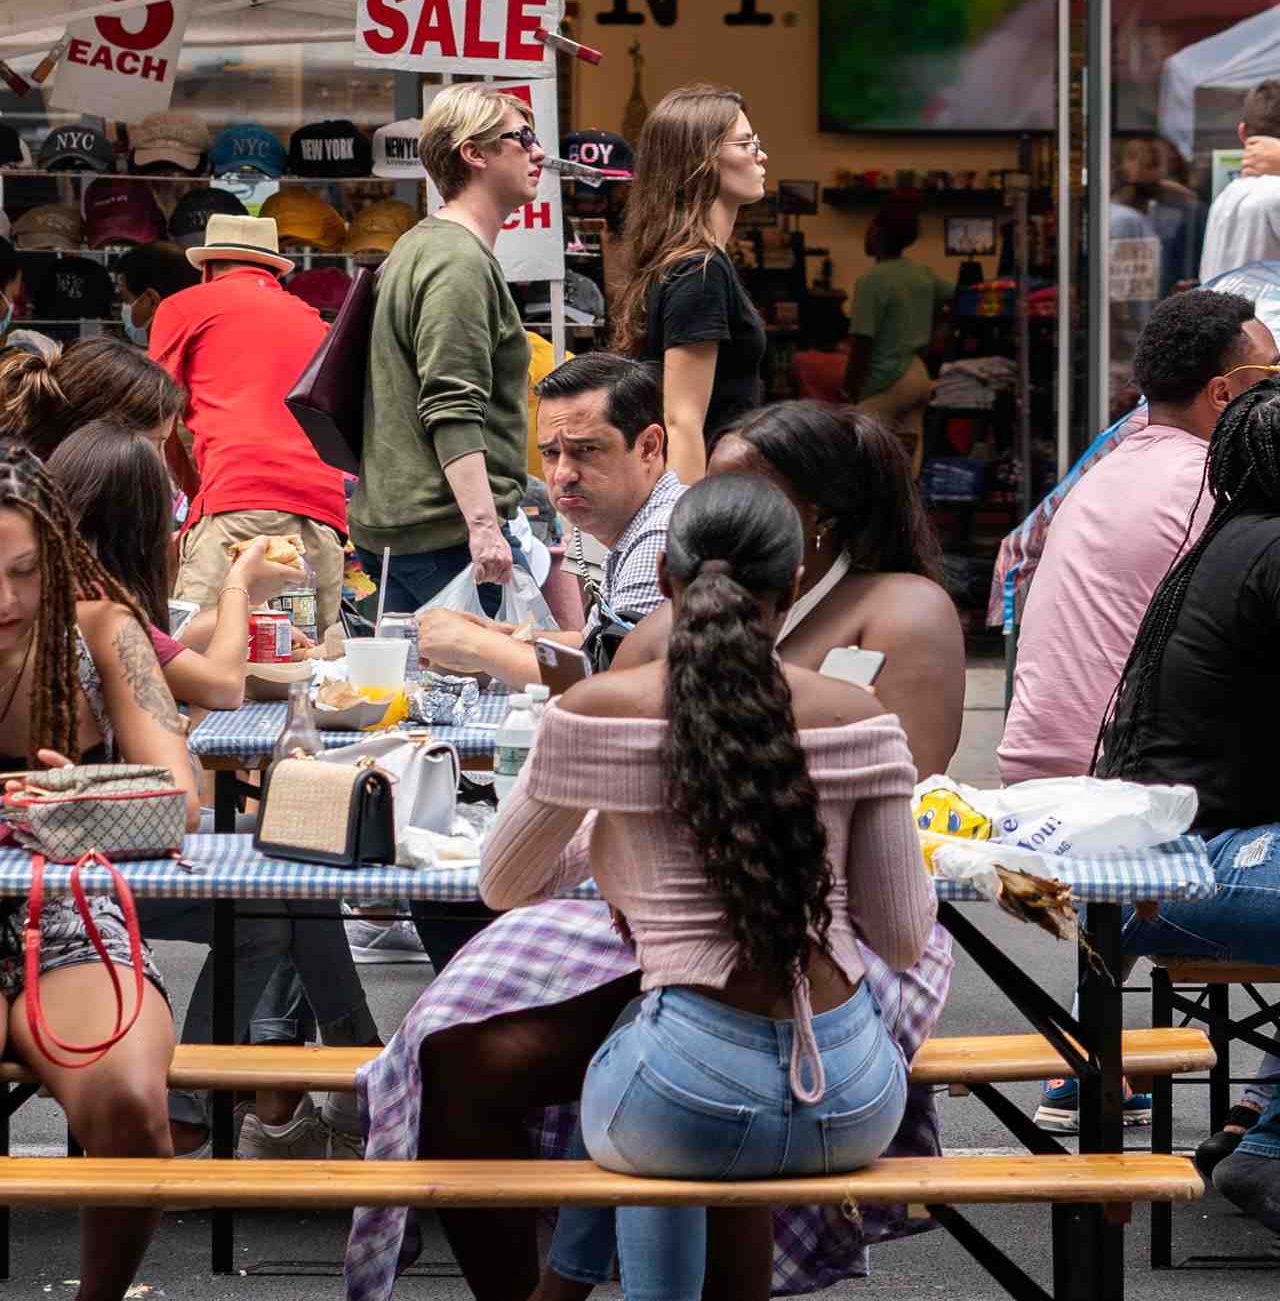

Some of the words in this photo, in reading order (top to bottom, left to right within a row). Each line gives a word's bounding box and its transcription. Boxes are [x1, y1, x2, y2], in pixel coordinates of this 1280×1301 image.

[66, 38, 169, 83] EACH
[55, 132, 96, 151] NYC
[232, 138, 270, 157] NYC
[300, 138, 322, 161] NEW
[325, 138, 355, 161] YORK
[500, 202, 551, 231] CH
